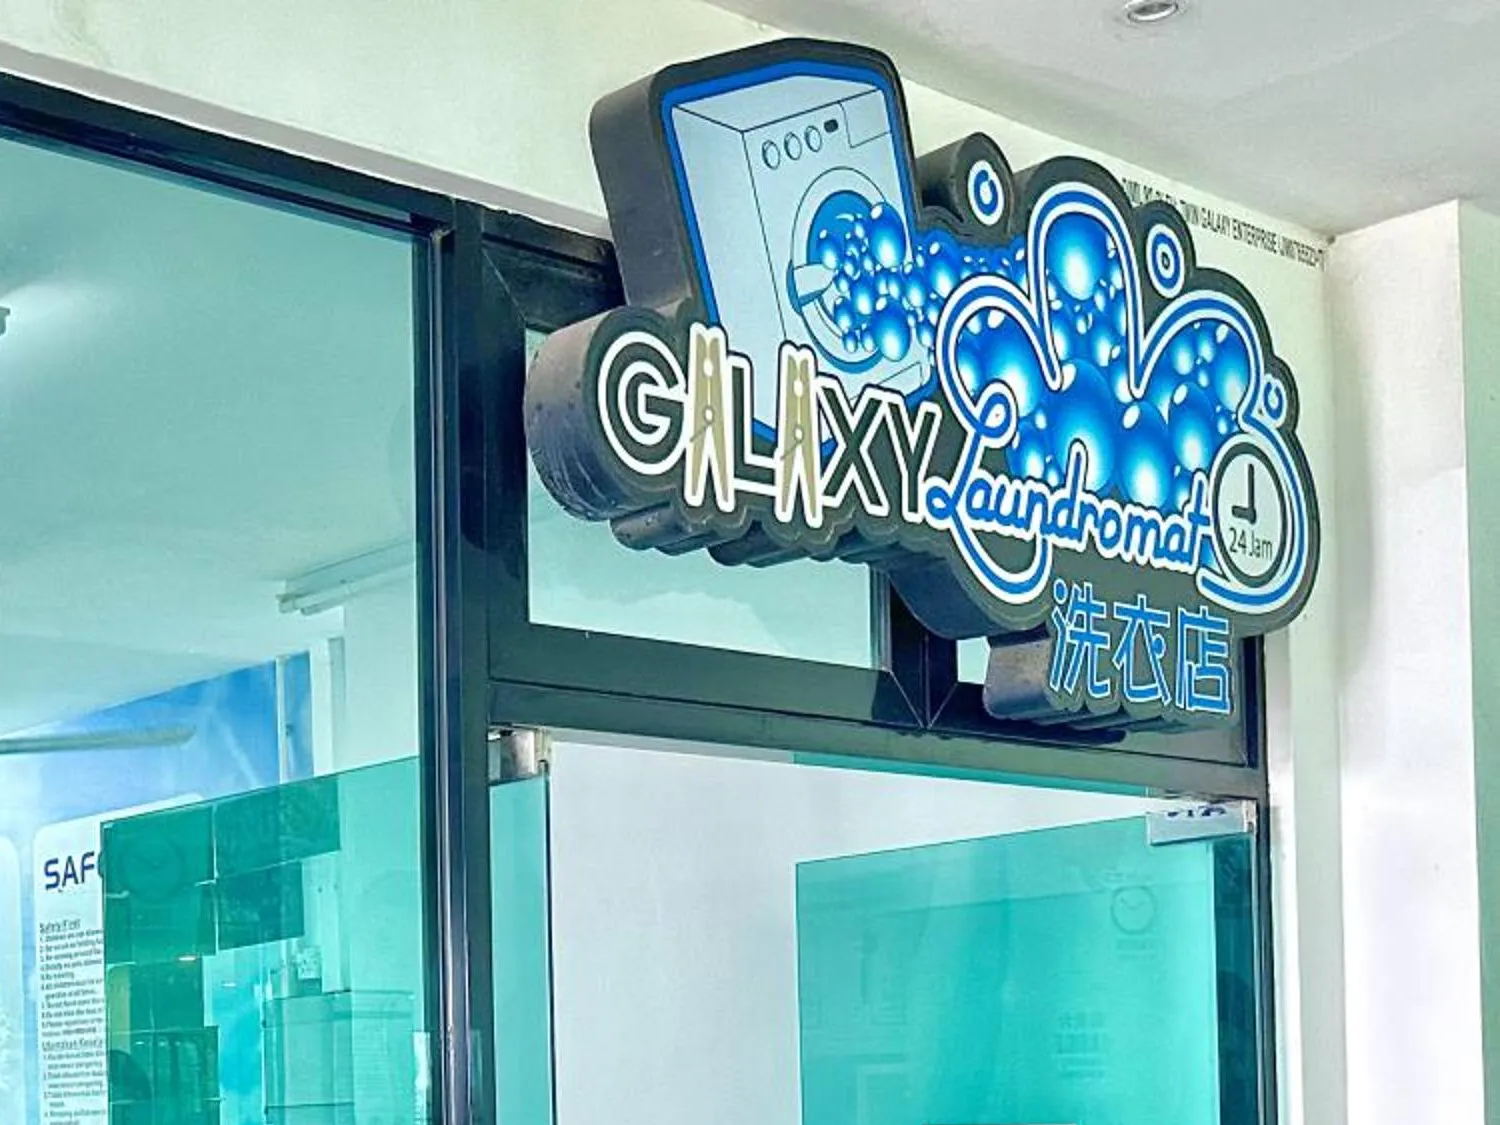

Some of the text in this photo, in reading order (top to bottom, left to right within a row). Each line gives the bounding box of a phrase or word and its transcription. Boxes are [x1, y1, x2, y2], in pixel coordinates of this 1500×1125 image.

[597, 322, 1211, 575] GALAXY Laundromat
[1229, 529, 1274, 561] 24 Jam
[1049, 579, 1234, 715] 洗衣店
